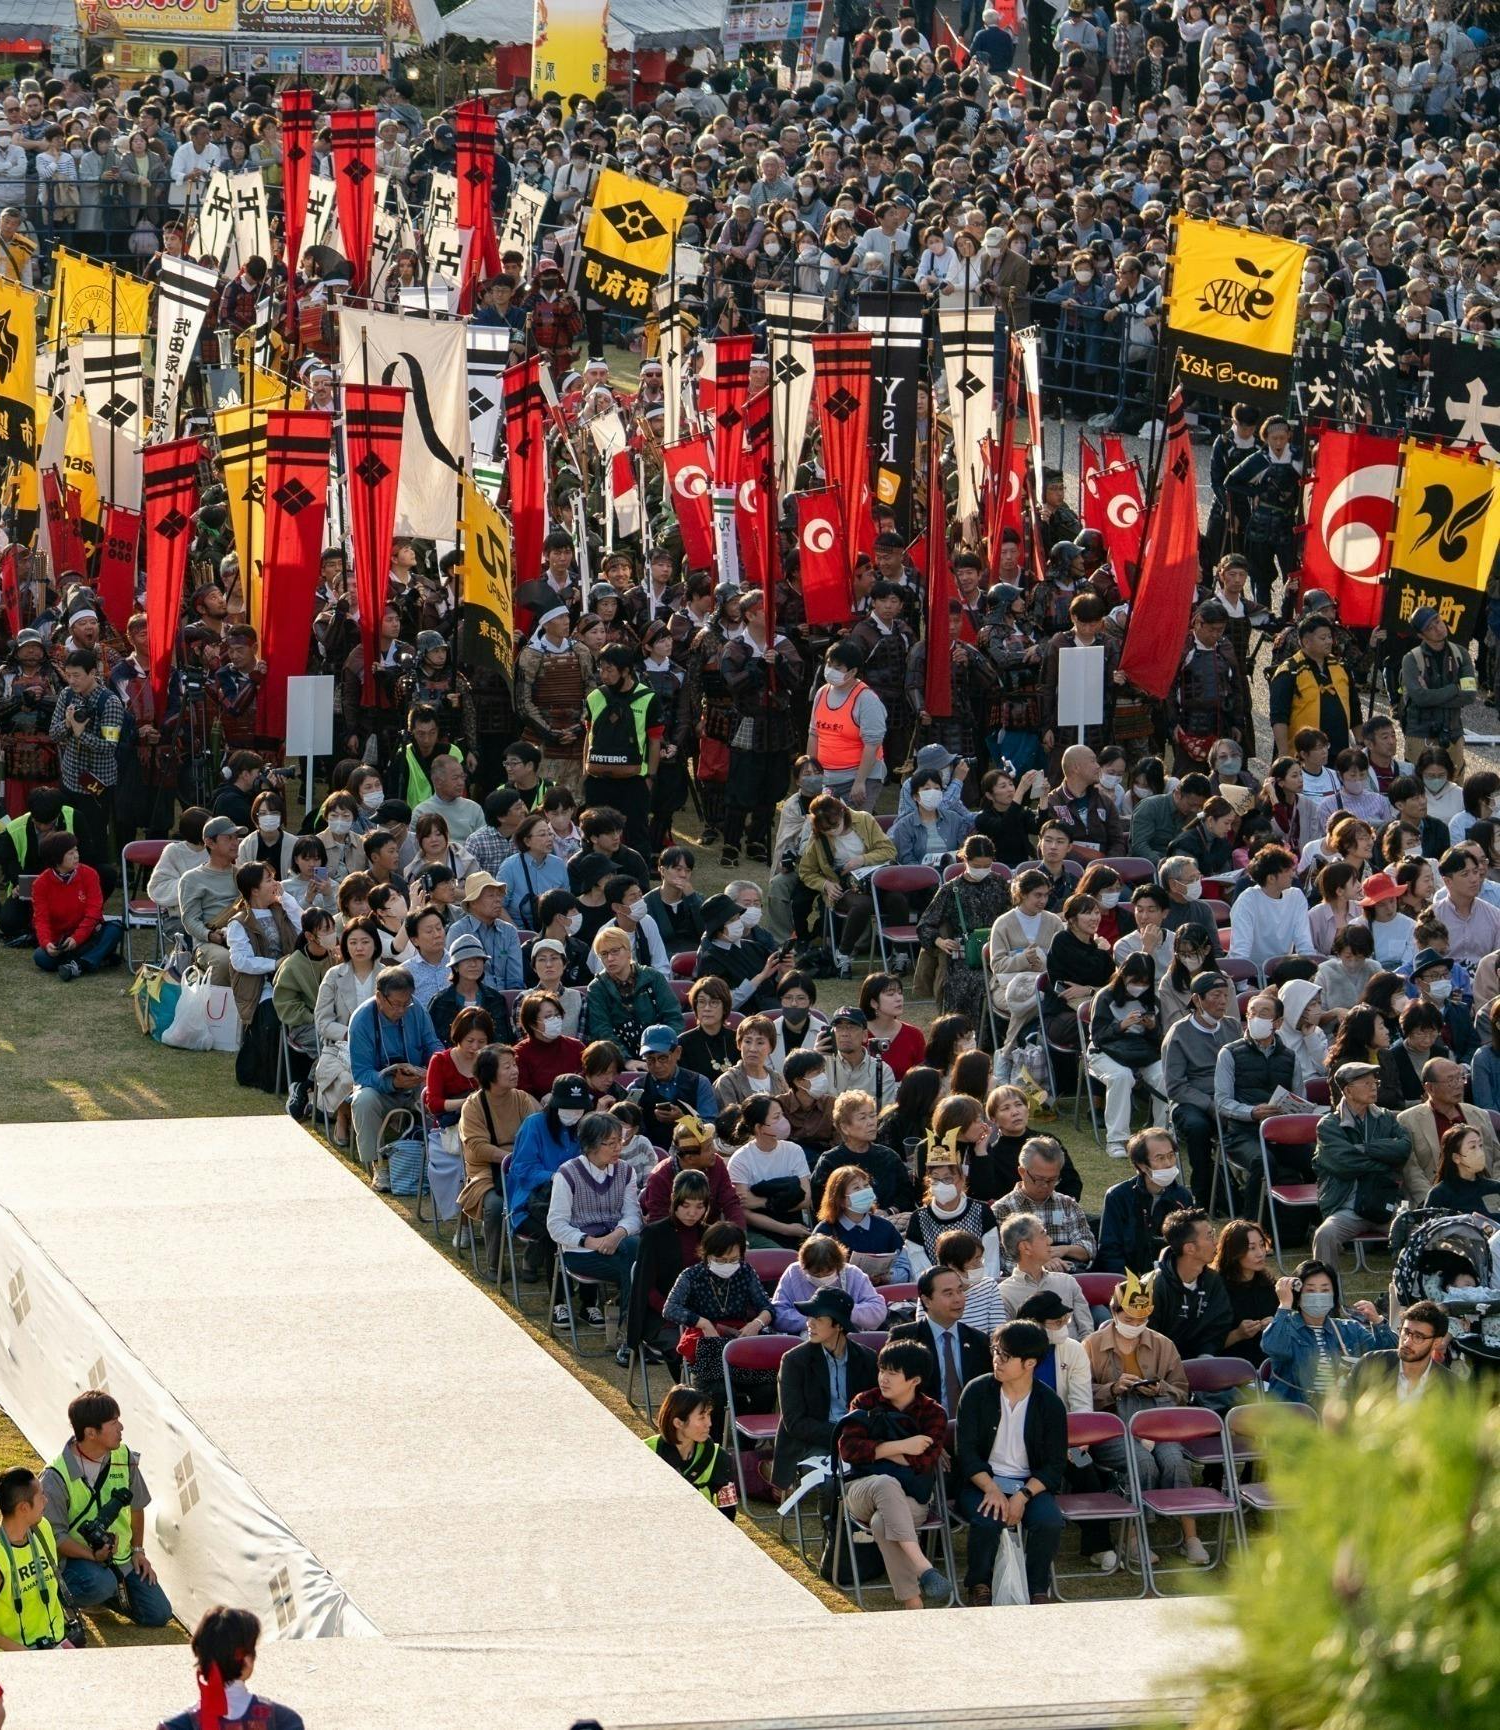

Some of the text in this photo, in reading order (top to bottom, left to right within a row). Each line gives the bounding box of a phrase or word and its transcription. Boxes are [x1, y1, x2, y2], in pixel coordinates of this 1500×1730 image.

[585, 260, 649, 307] 甲府市
[1180, 353, 1214, 378] Ysk
[590, 753, 628, 763] HYSTERIC
